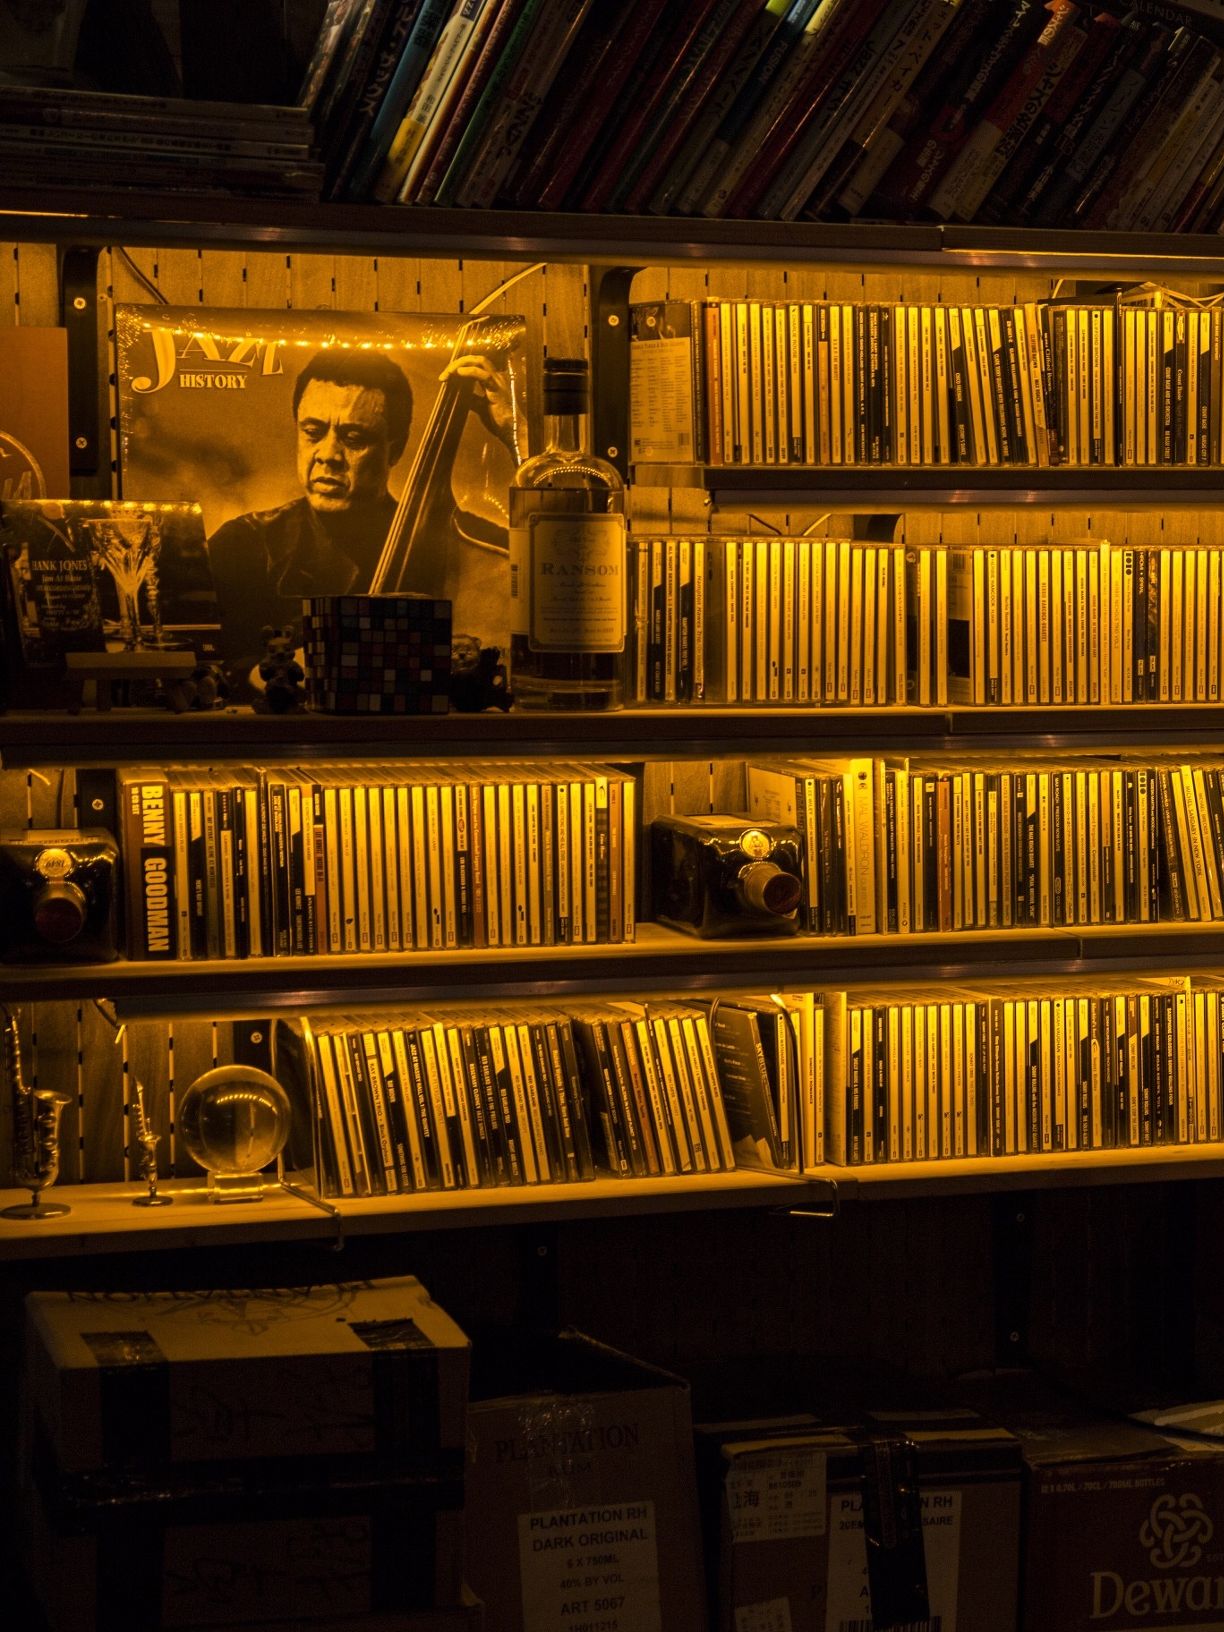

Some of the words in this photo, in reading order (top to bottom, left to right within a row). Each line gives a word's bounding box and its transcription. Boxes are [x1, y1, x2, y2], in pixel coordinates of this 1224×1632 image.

[179, 372, 248, 390] HISTORY
[541, 563, 618, 576] RANSOM
[132, 796, 139, 805] CD
[859, 797, 868, 818] MAL
[132, 806, 140, 815] SET
[141, 786, 166, 845] BENNY
[859, 820, 869, 875] WALDRON
[143, 858, 169, 951] GOODMAN
[530, 1508, 624, 1531] PLANTATION
[626, 1507, 648, 1521] RH
[532, 1535, 574, 1552] DARK
[578, 1528, 648, 1547] ORIGINAL
[576, 1558, 583, 1567] X
[585, 1576, 599, 1587] BY
[603, 1574, 624, 1584] VOL
[560, 1602, 589, 1616] ART
[594, 1597, 625, 1611] 5067
